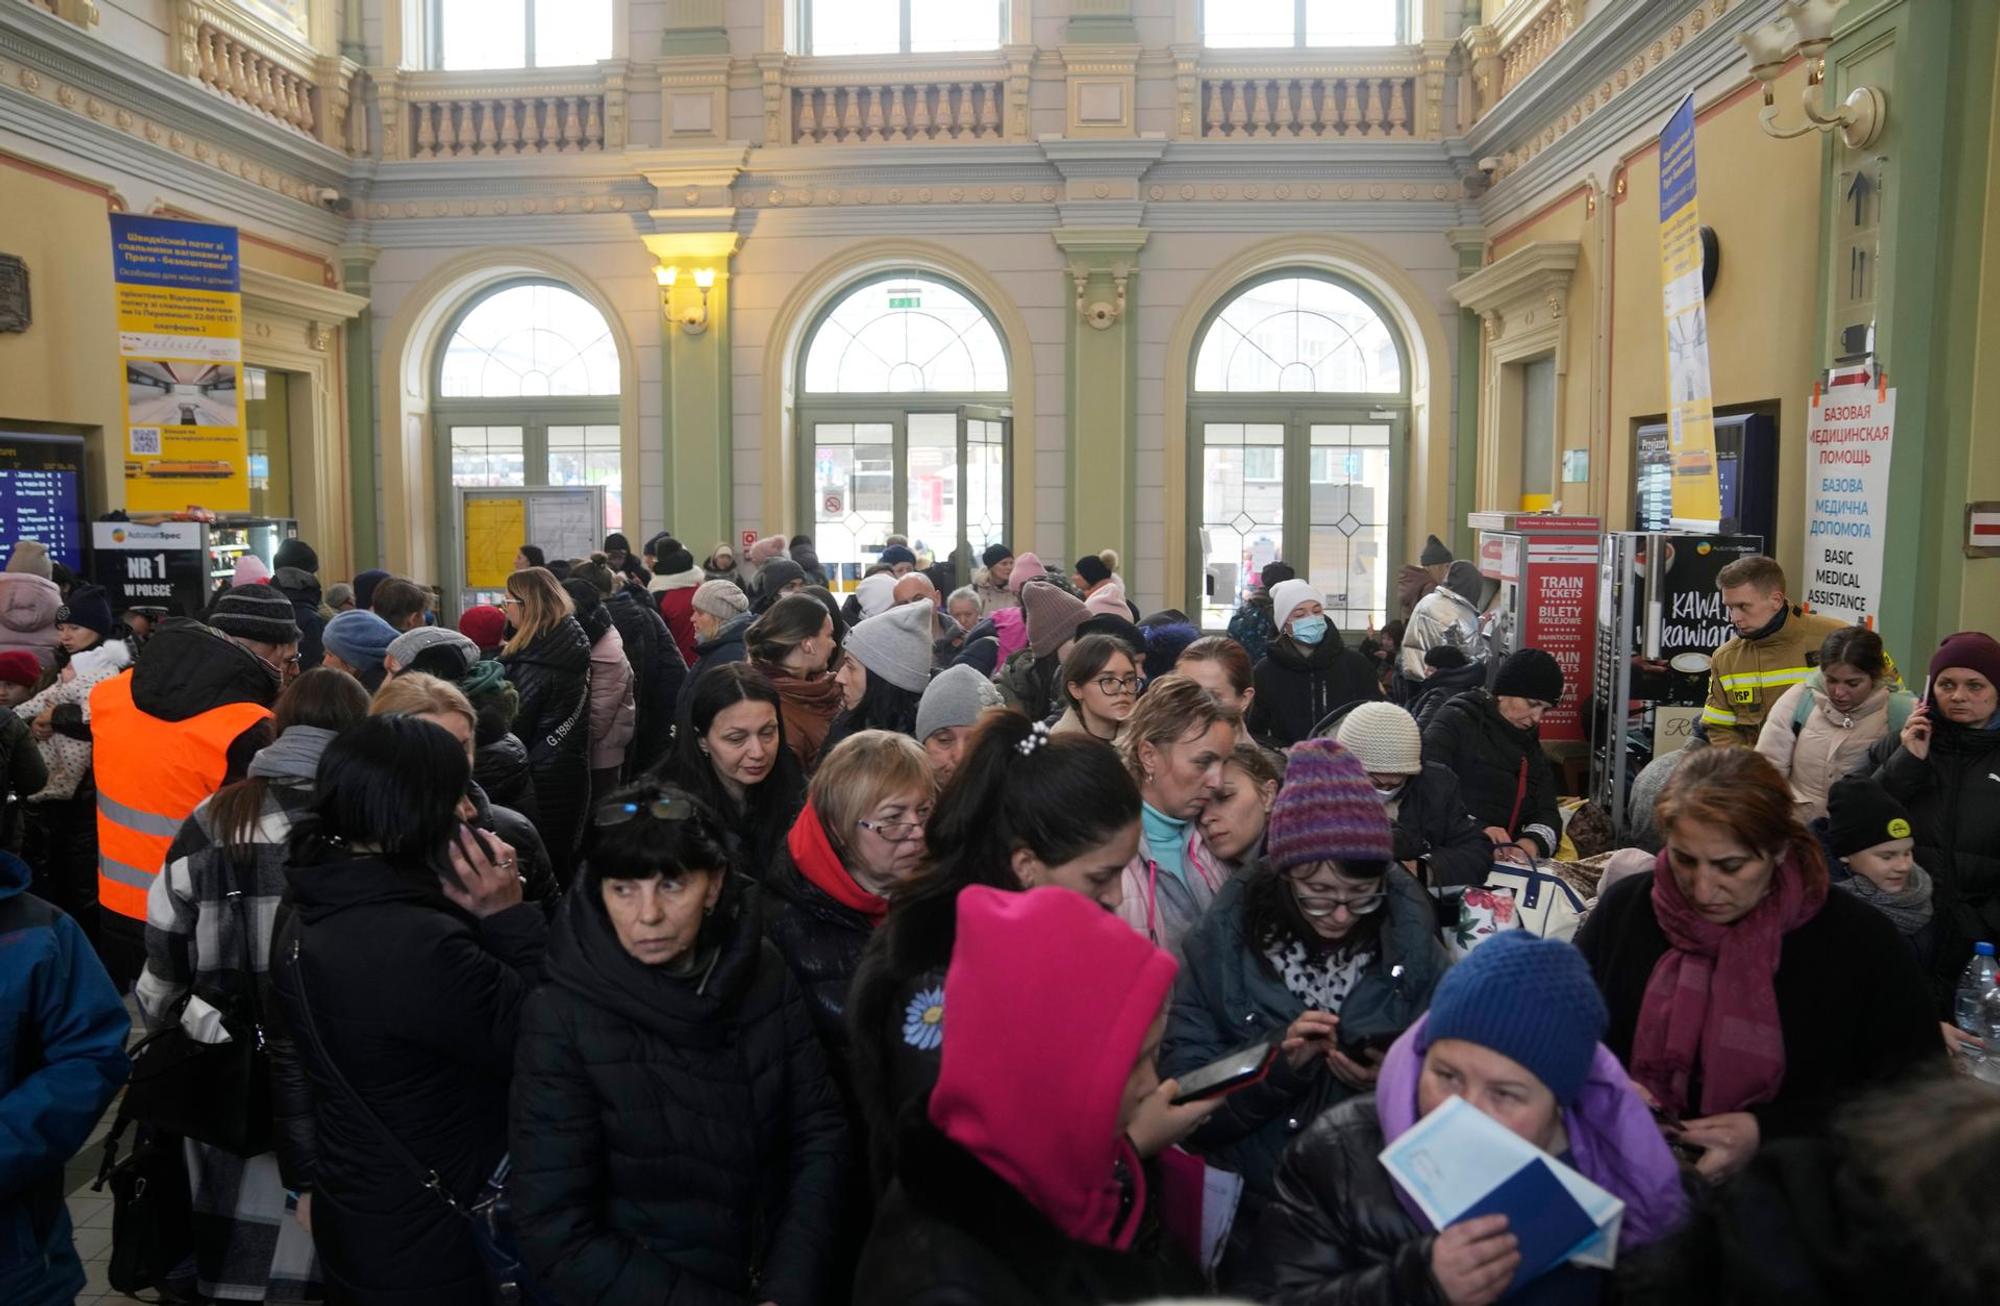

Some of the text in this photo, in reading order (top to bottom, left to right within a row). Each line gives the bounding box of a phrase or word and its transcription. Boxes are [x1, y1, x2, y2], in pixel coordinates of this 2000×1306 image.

[1824, 404, 1872, 422] БАЗОВАЯ
[1819, 449, 1872, 467] ПОМОЩЬ
[1822, 478, 1864, 493] БАЗОВА
[1815, 498, 1869, 516] МЕДИЧНА
[1810, 519, 1872, 539] ДОПОМОГА
[127, 553, 166, 579] NR 1
[1824, 549, 1854, 566] BASIC
[1539, 576, 1584, 588] TRAIN
[1816, 569, 1861, 589] MEDICAL
[123, 584, 135, 597] W
[1540, 588, 1583, 598] TICKETS
[1672, 591, 1721, 620] KAWA
[1807, 589, 1866, 612] ASSISTANCE
[1538, 606, 1582, 617] BILETY
[1538, 617, 1582, 625] KOLEJOWE
[1661, 617, 1736, 648] kawiar
[1735, 690, 1750, 702] PSP
